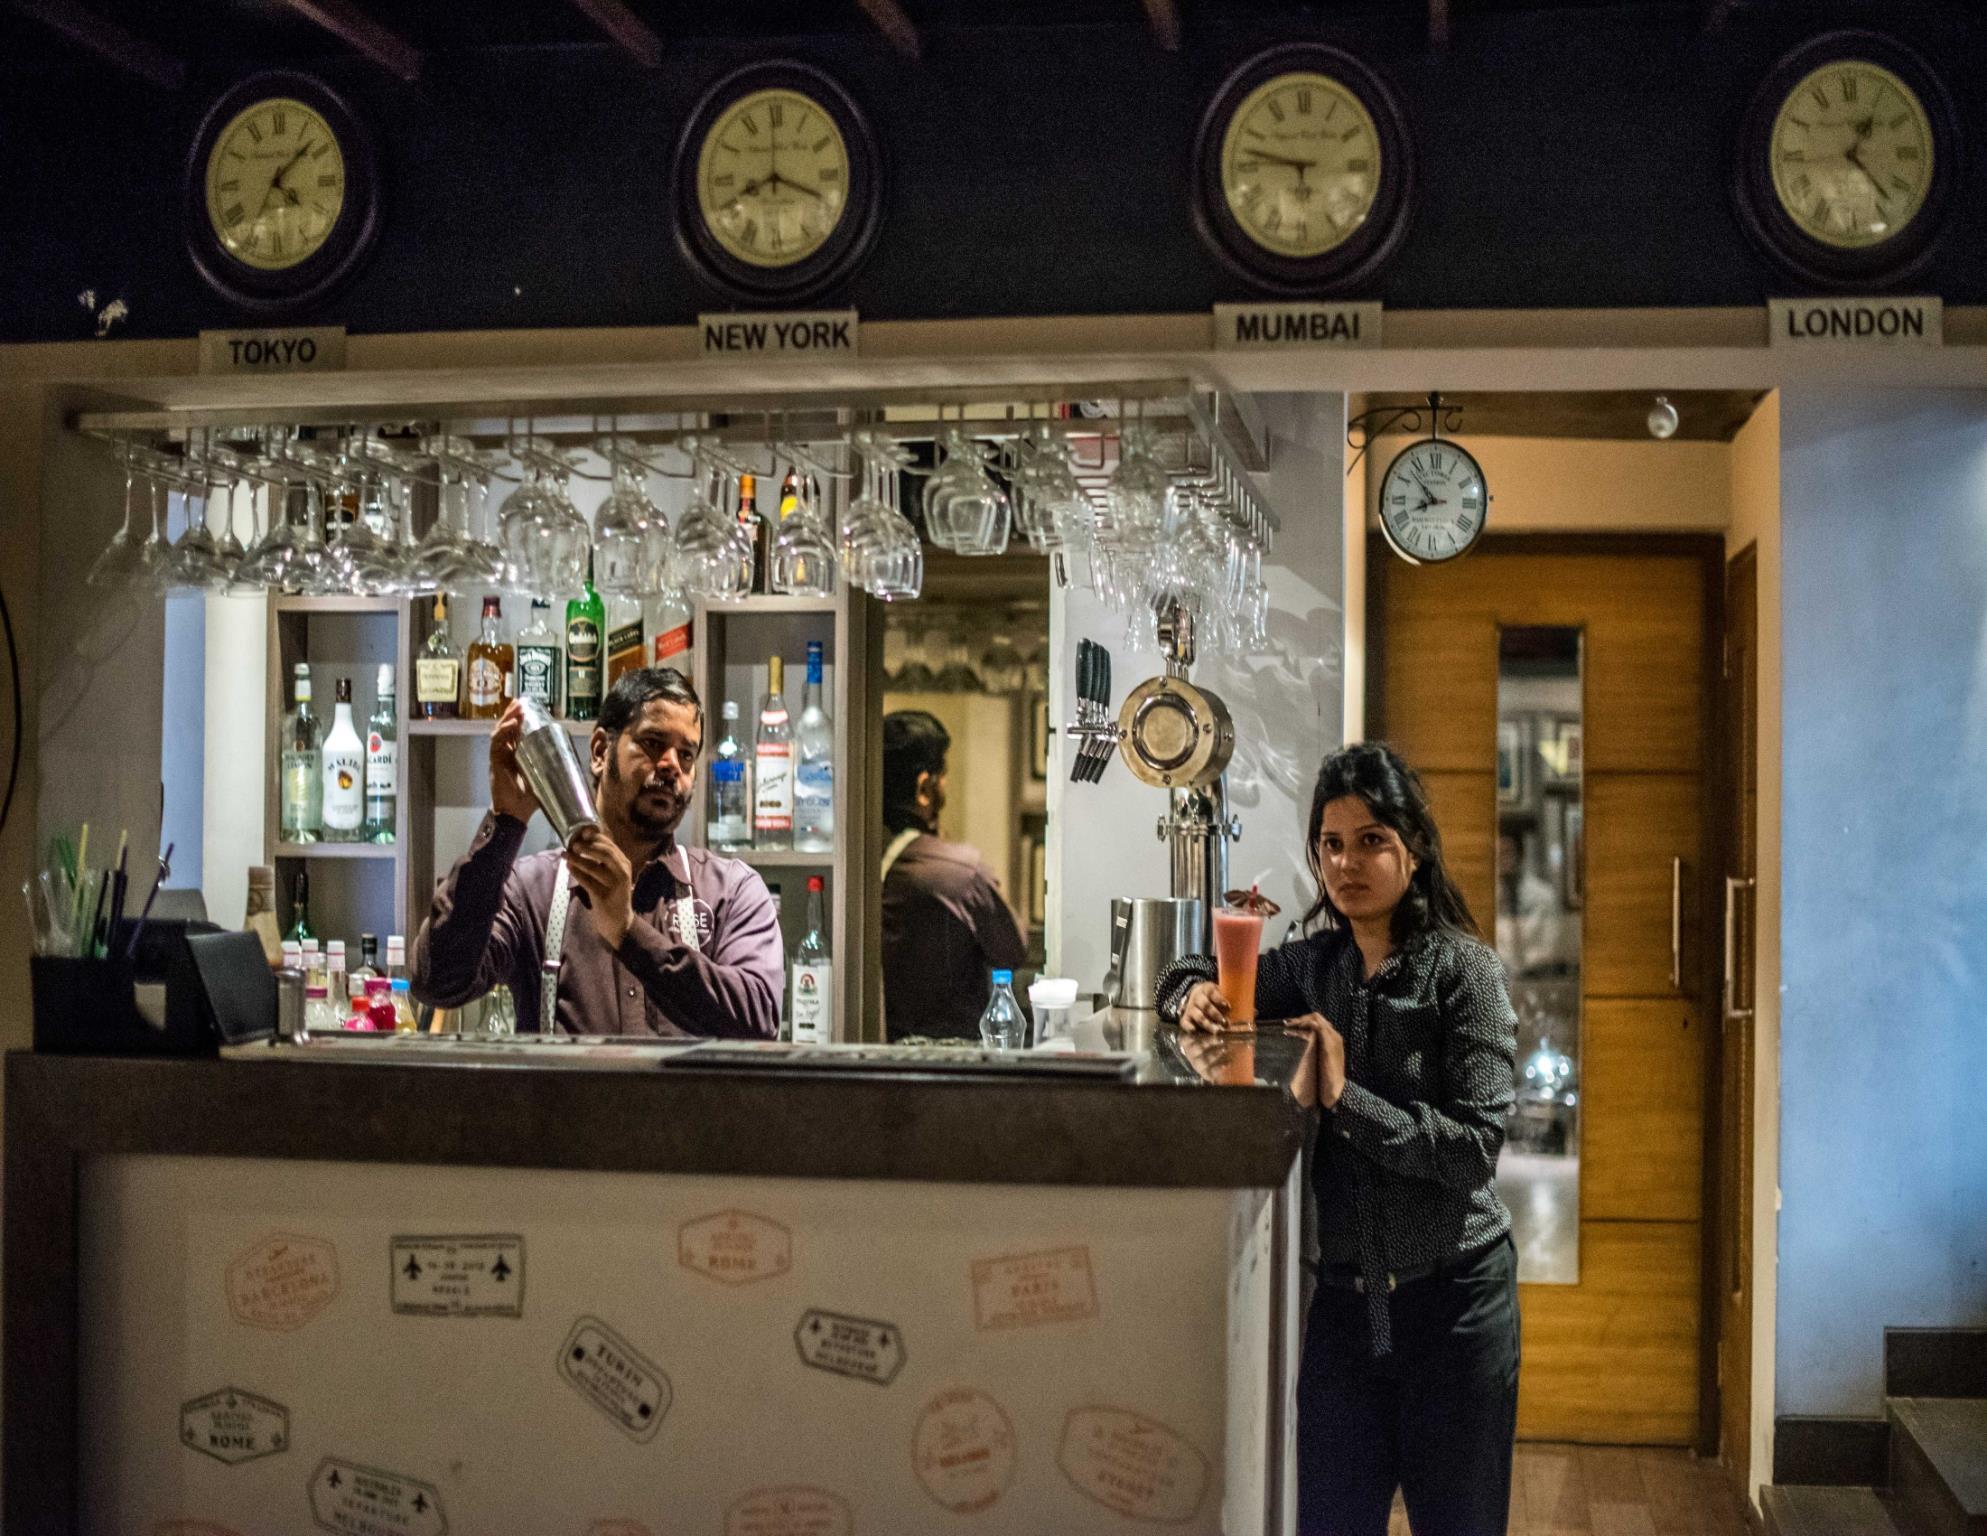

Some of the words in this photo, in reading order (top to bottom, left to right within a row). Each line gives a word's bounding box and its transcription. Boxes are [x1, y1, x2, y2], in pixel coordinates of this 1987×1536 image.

[705, 323, 767, 351] NEW
[774, 320, 850, 350] YORK
[1236, 312, 1359, 342] MUMBAI
[1788, 307, 1923, 338] LONDON
[228, 338, 317, 366] TOKYO
[597, 1342, 644, 1388] TURIN
[209, 1434, 255, 1451] ROME
